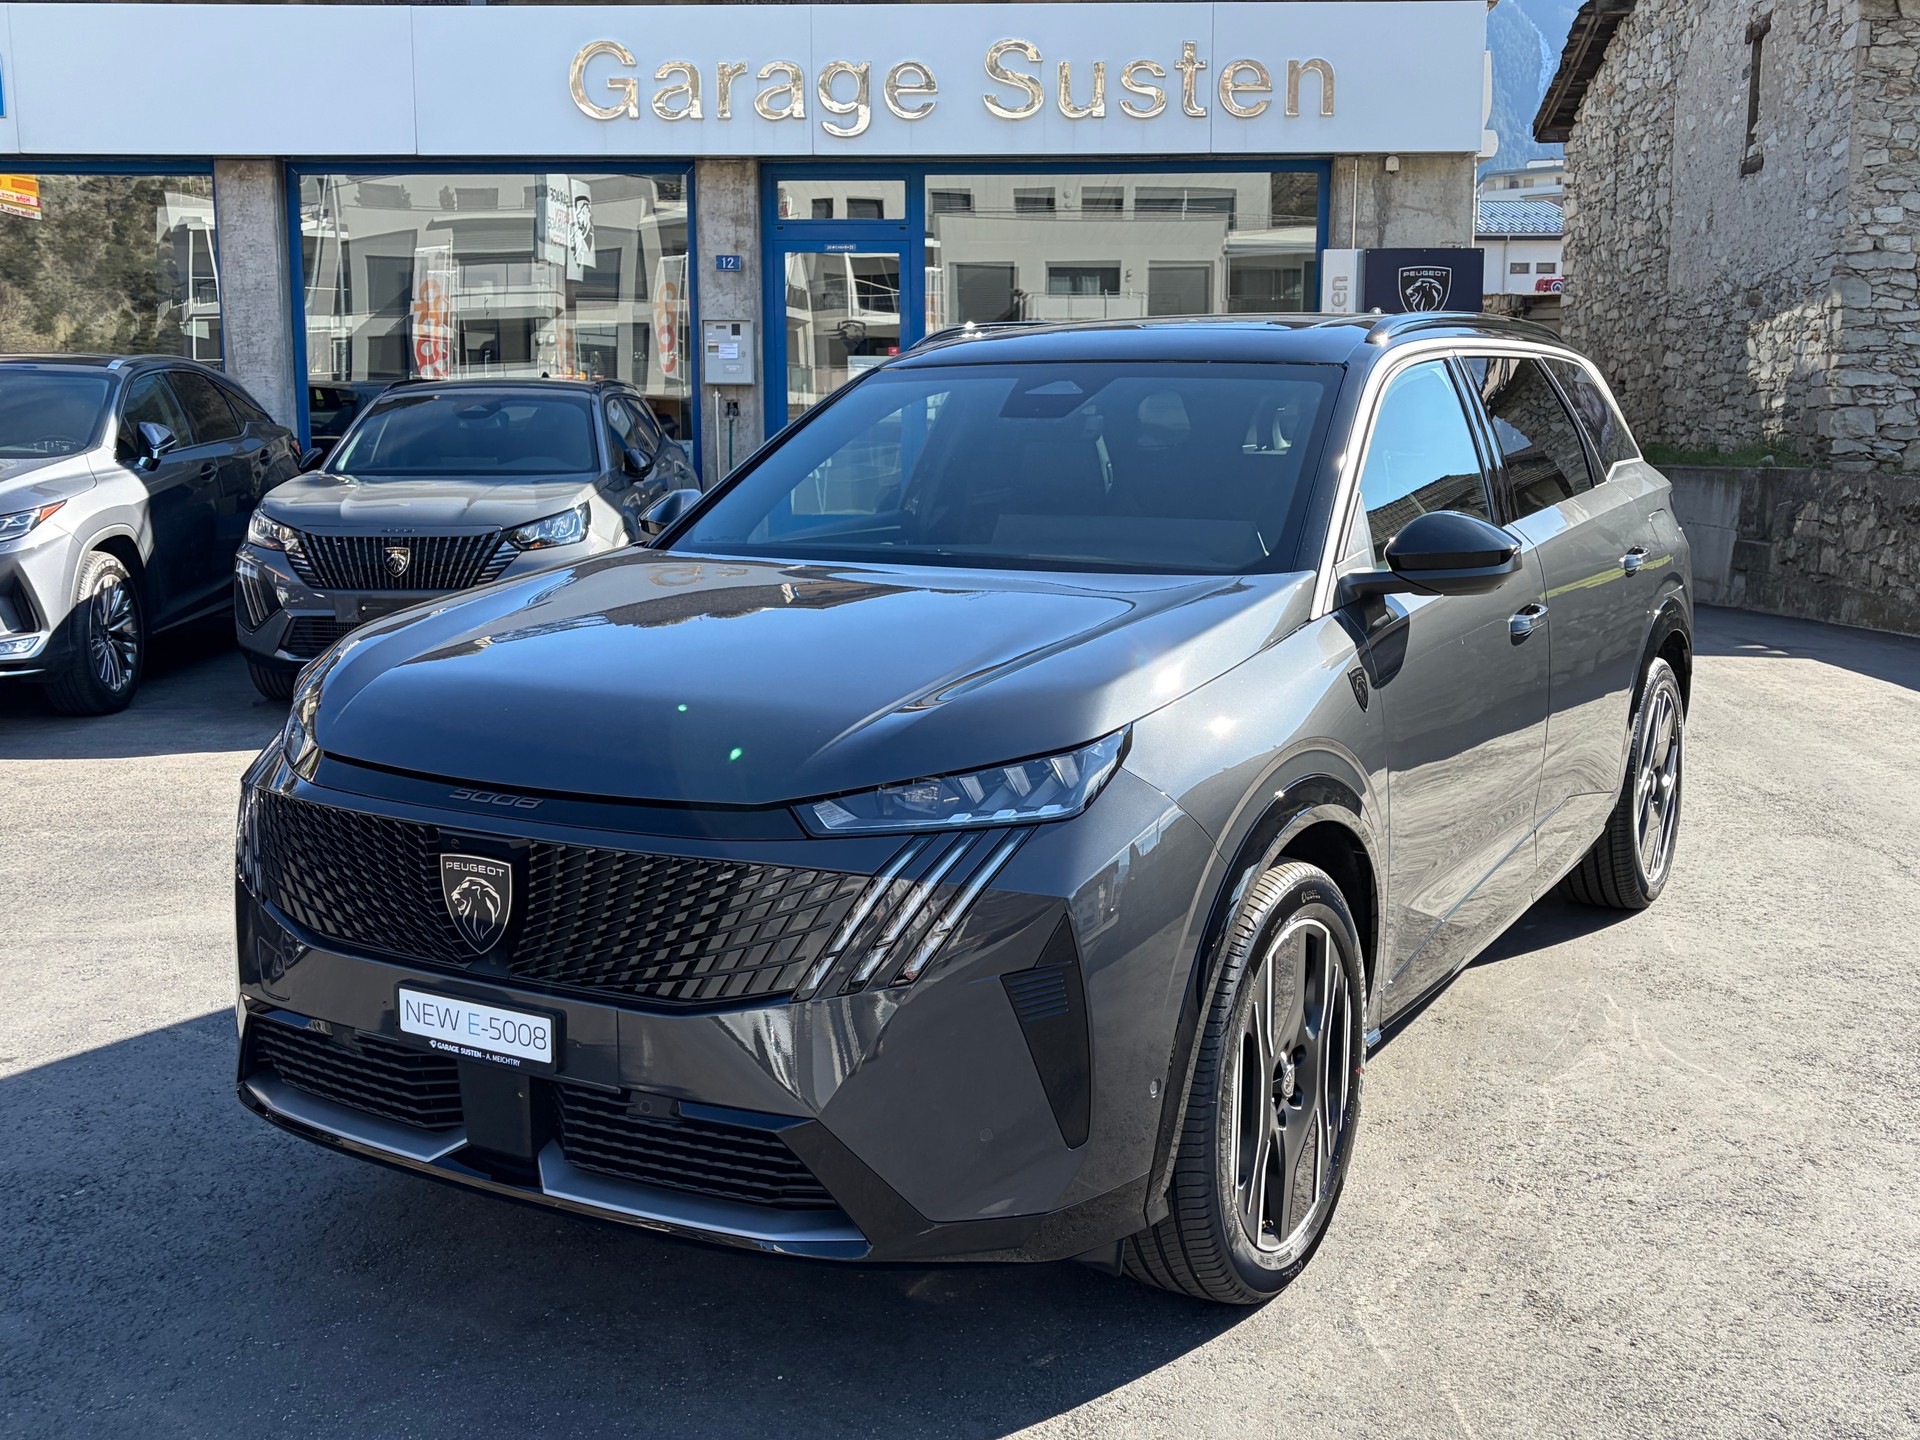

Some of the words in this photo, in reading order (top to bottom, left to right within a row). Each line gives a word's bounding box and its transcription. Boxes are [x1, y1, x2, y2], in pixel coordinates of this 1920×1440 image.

[569, 40, 938, 137] Garage
[983, 38, 1335, 119] Susten
[721, 257, 735, 269] 12
[1331, 275, 1349, 312] en
[449, 788, 544, 809] 5008
[445, 861, 505, 877] PEUGEOT
[406, 999, 460, 1031] NEW
[468, 1012, 547, 1050] E-5008
[437, 1042, 460, 1054] GARAGE
[460, 1047, 482, 1059] SUSTEN
[486, 1053, 492, 1061] A.
[492, 1054, 521, 1067] MEICHTRY
